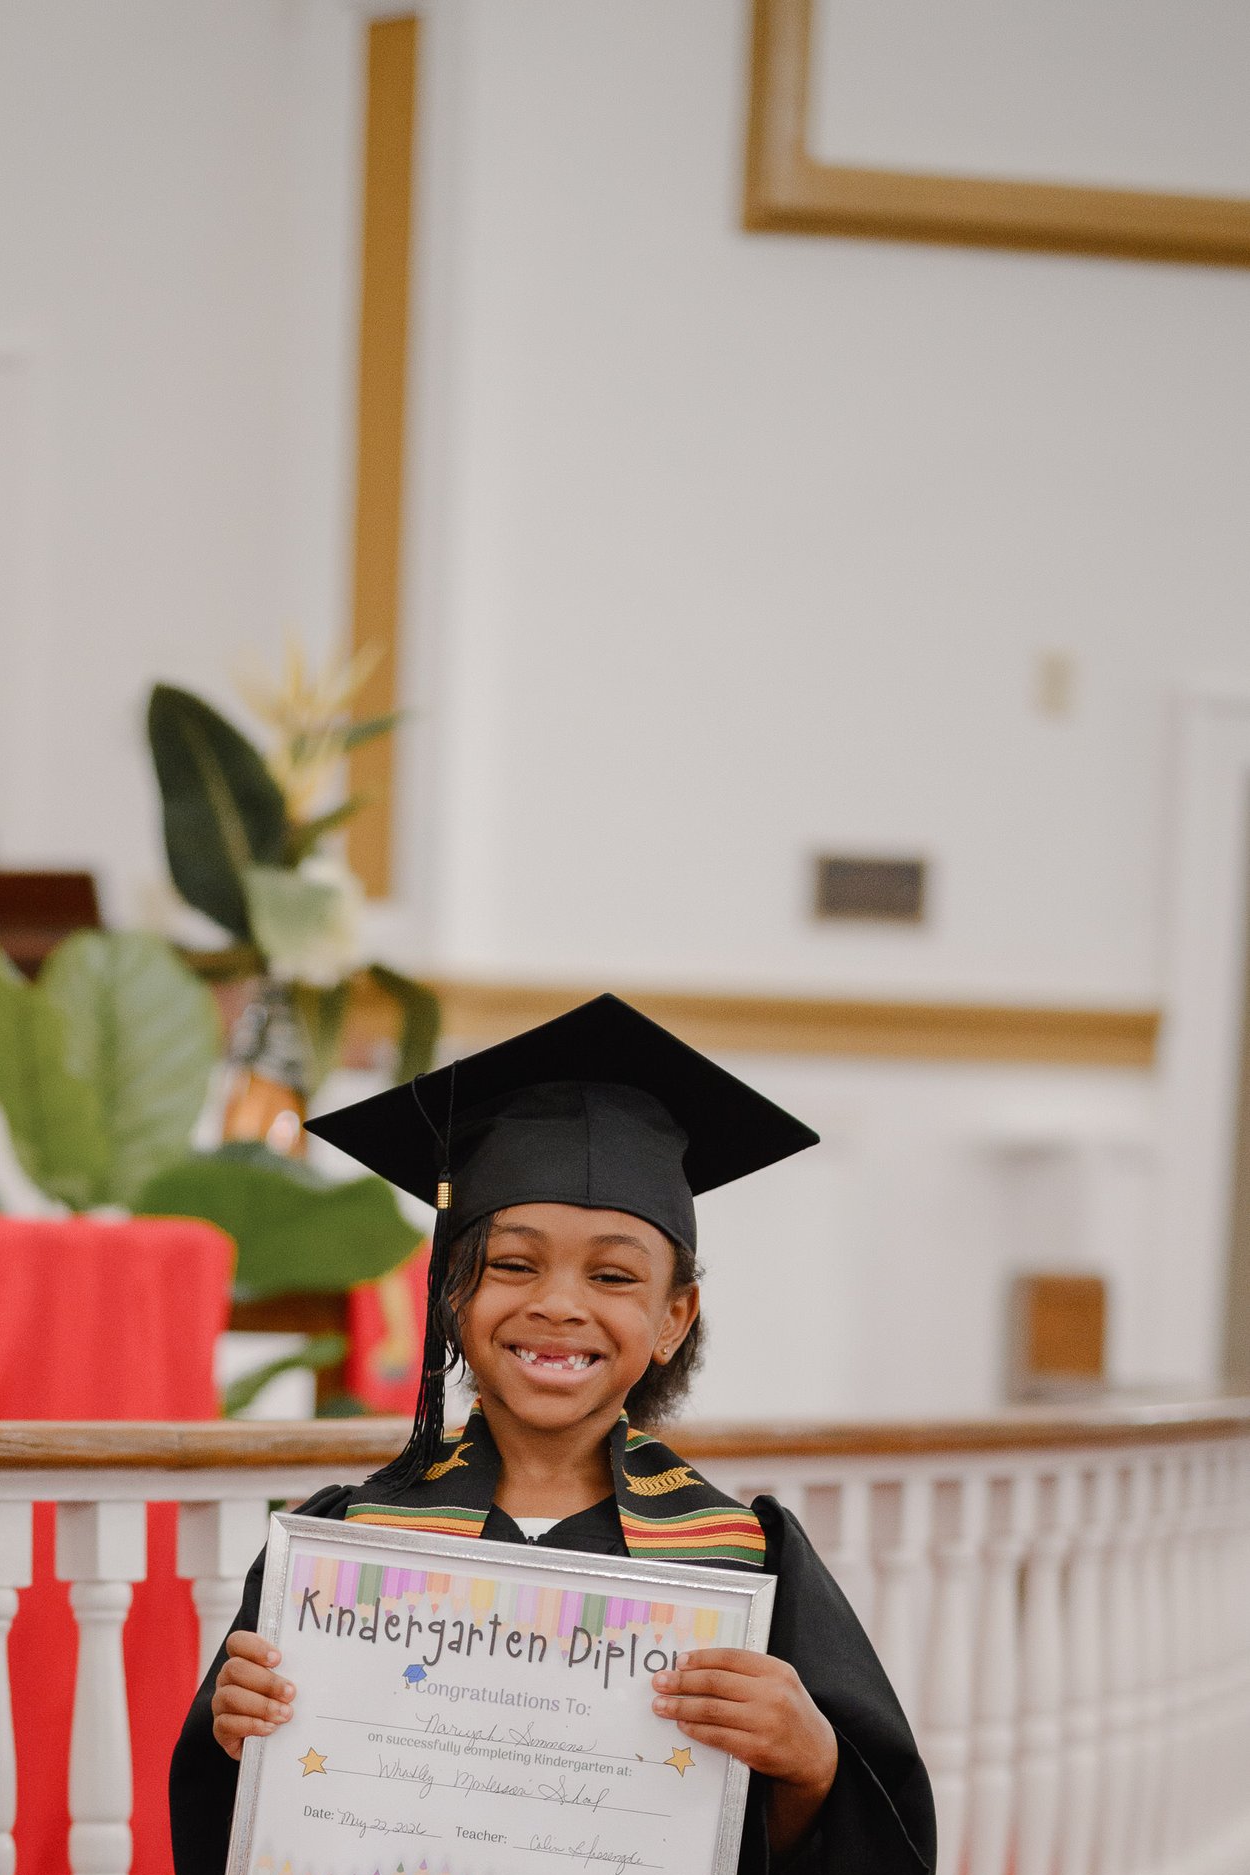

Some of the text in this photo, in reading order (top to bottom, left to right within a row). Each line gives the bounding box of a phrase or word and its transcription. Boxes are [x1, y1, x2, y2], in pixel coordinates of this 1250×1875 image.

[297, 1587, 678, 1689] Kindergarten Diplo
[415, 1680, 592, 1716] Congratulations To:
[367, 1732, 633, 1777] on successfully completing Kindergarten at:
[303, 1805, 335, 1820] Date:
[455, 1825, 508, 1844] Teacher:
